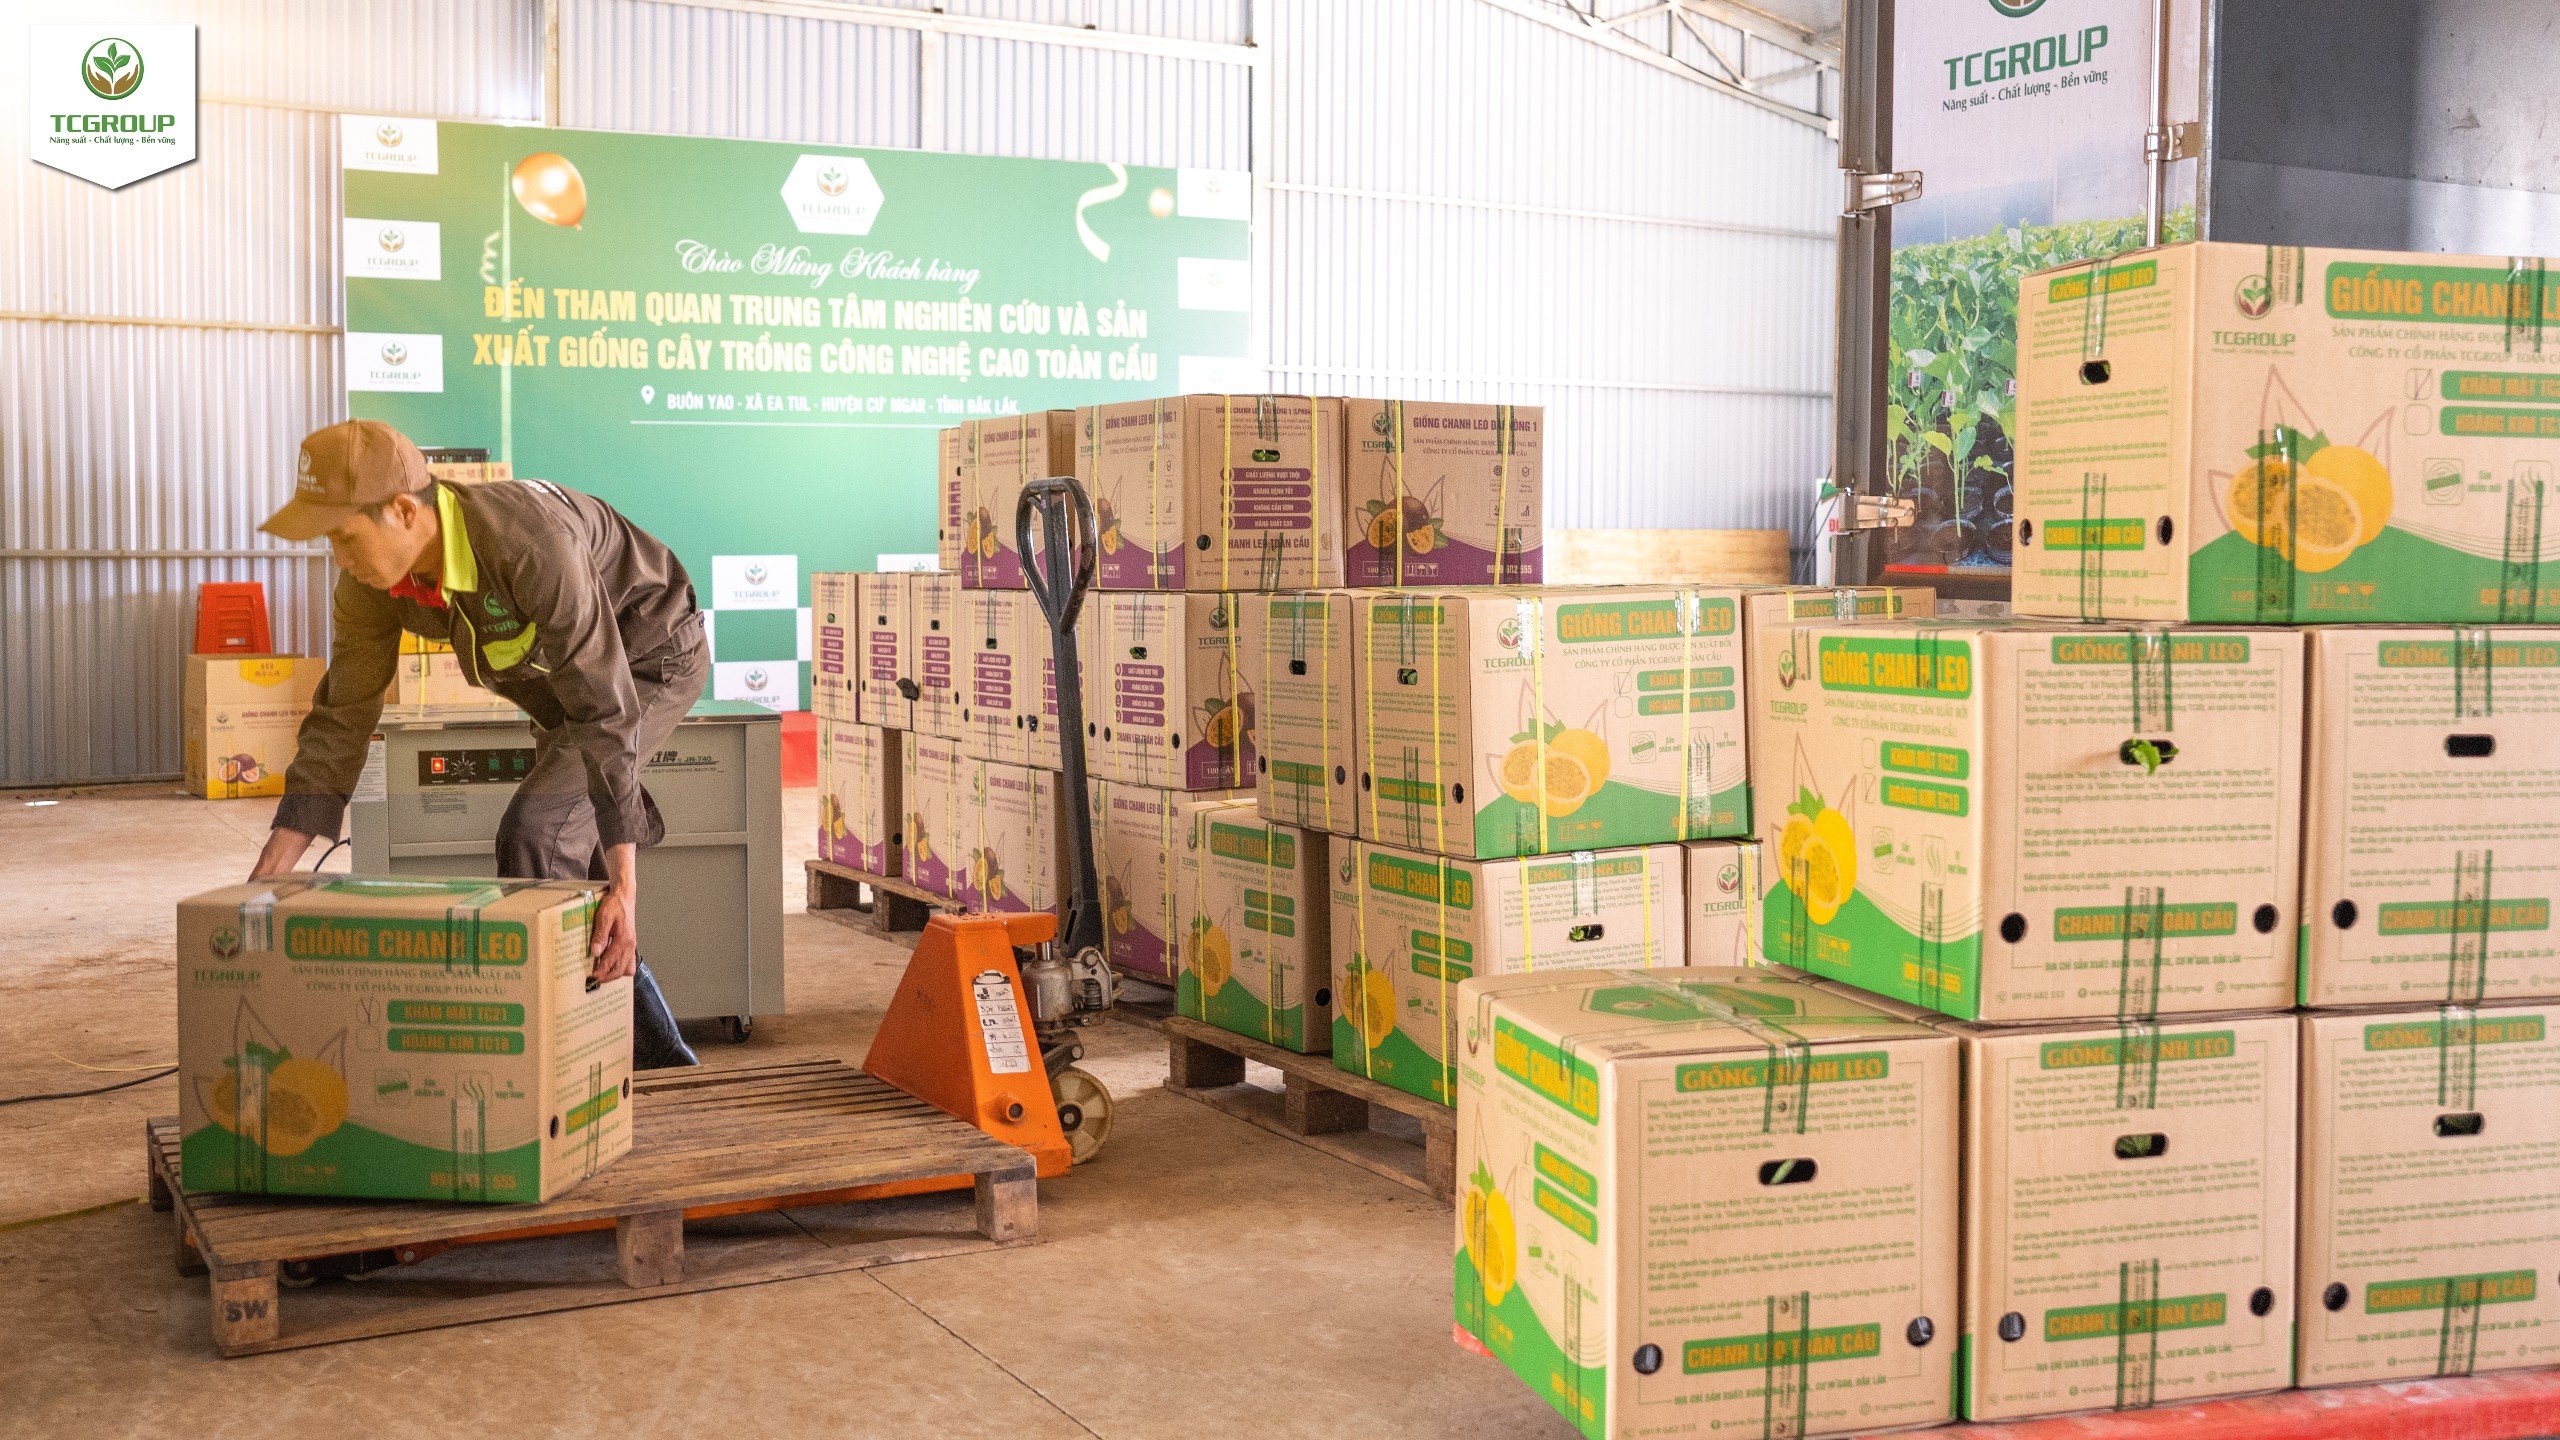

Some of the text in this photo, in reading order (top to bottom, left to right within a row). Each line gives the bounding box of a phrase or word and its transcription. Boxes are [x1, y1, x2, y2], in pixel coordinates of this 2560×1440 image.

[1943, 24, 2108, 91] TCGROUP
[1942, 69, 2108, 112] Năng suất Chất lượng Bền vững
[675, 239, 981, 295] Chào Mừng Khách hàng
[2332, 264, 2531, 319] GIỐNG CHANH
[483, 277, 1147, 339] ĐẾN THAM QUAN TRUNG TÂM NGHIÊN CỨU VÀ SẢN
[472, 324, 1158, 383] XUẤT GIỐNG CÂY TRỒNG CÔNG NGHỆ CAO TOÀN CẦU
[2212, 330, 2296, 348] TCGROUP
[2386, 348, 2402, 360] TY
[667, 393, 704, 410] BUÔN
[707, 395, 734, 410] YAO
[746, 392, 764, 411] XÃ
[767, 396, 784, 411] EA
[822, 395, 864, 415] HUYỆN
[1413, 417, 1440, 429] GIỐNG
[1442, 418, 1472, 430] CHANH
[1473, 419, 1489, 430] LEO
[1511, 419, 1531, 432] ÔNG
[1561, 605, 1732, 640] GIỐNG CHAN LEO
[1575, 659, 1598, 670] CÔNG
[1600, 659, 1609, 668] TY
[1648, 655, 1682, 665] TCGROUP
[1581, 645, 1605, 656] PHẨM
[1605, 644, 1632, 655] CHÍNH
[1634, 642, 1657, 654] HÀNG
[1682, 641, 1697, 651] SN
[2057, 638, 2244, 663] GIỐNG LEO
[1822, 640, 1969, 692] GIỐNG CHANH LEO
[290, 920, 522, 960] GIỐNG CHANH LEO
[2058, 914, 2116, 936] CHANH
[2047, 1040, 2116, 1067] GIỐNG
[1682, 1058, 1883, 1091] GIỐNG LEO
[226, 1299, 269, 1323] SW
[2048, 1312, 2106, 1337] CHANH
[1688, 1326, 1878, 1369] CHANH CẦU
